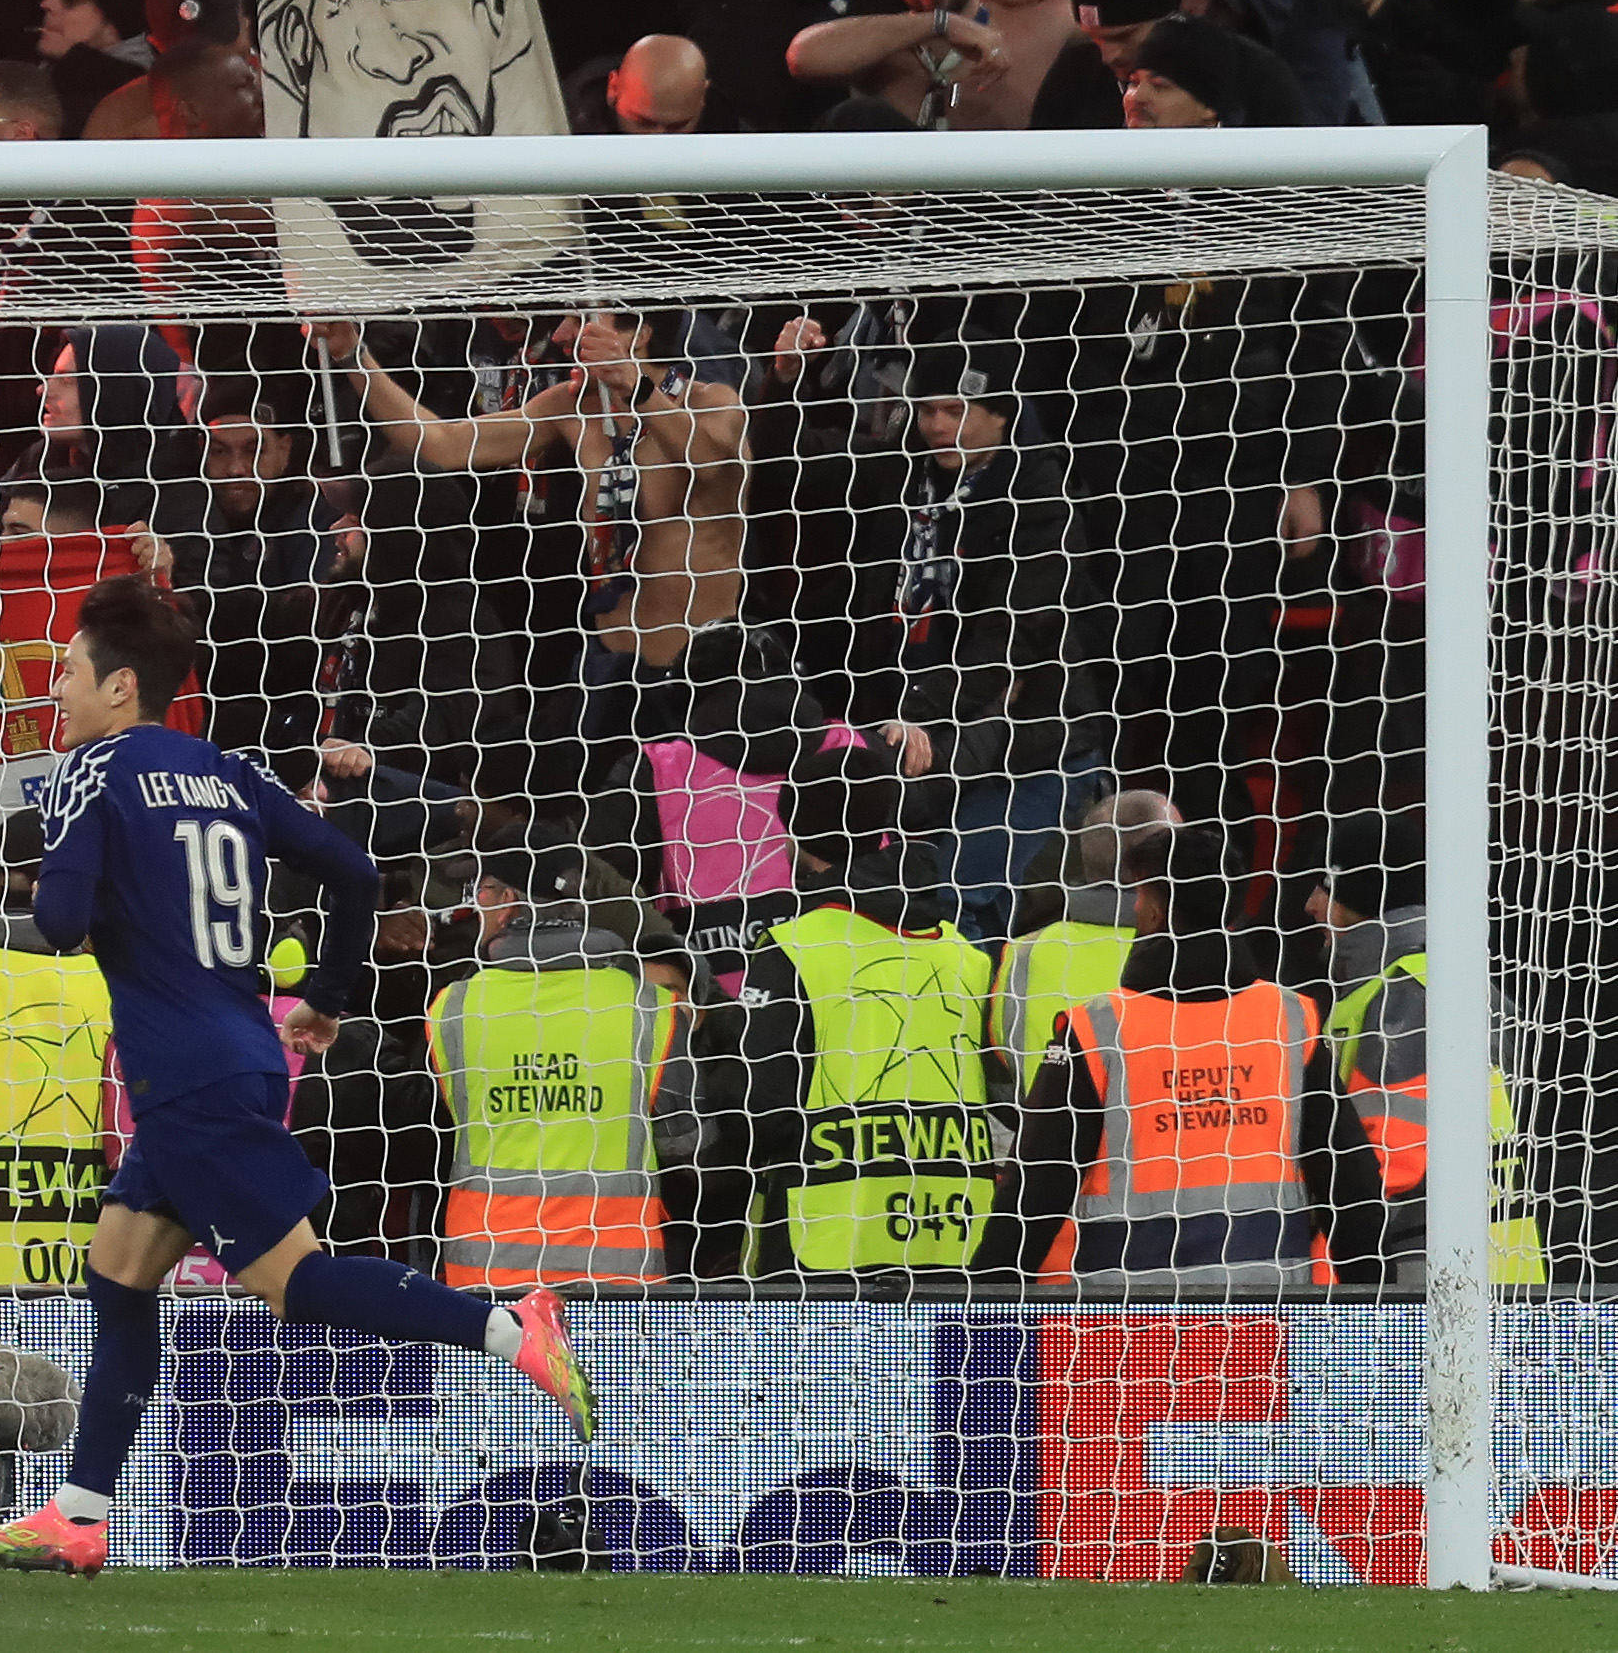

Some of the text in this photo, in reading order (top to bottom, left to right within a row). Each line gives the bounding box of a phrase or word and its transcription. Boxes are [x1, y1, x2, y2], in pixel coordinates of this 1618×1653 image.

[136, 771, 179, 809] LEE
[173, 773, 230, 810] KANG
[172, 819, 254, 971] 19
[513, 1052, 579, 1081] HEAD
[1162, 1065, 1254, 1089] DEPUTY
[489, 1085, 604, 1114] STEWARD
[1178, 1087, 1241, 1109] HEAD
[1155, 1107, 1268, 1133] STEWARD
[810, 1115, 992, 1170] STEWAR
[886, 1191, 974, 1242] 849
